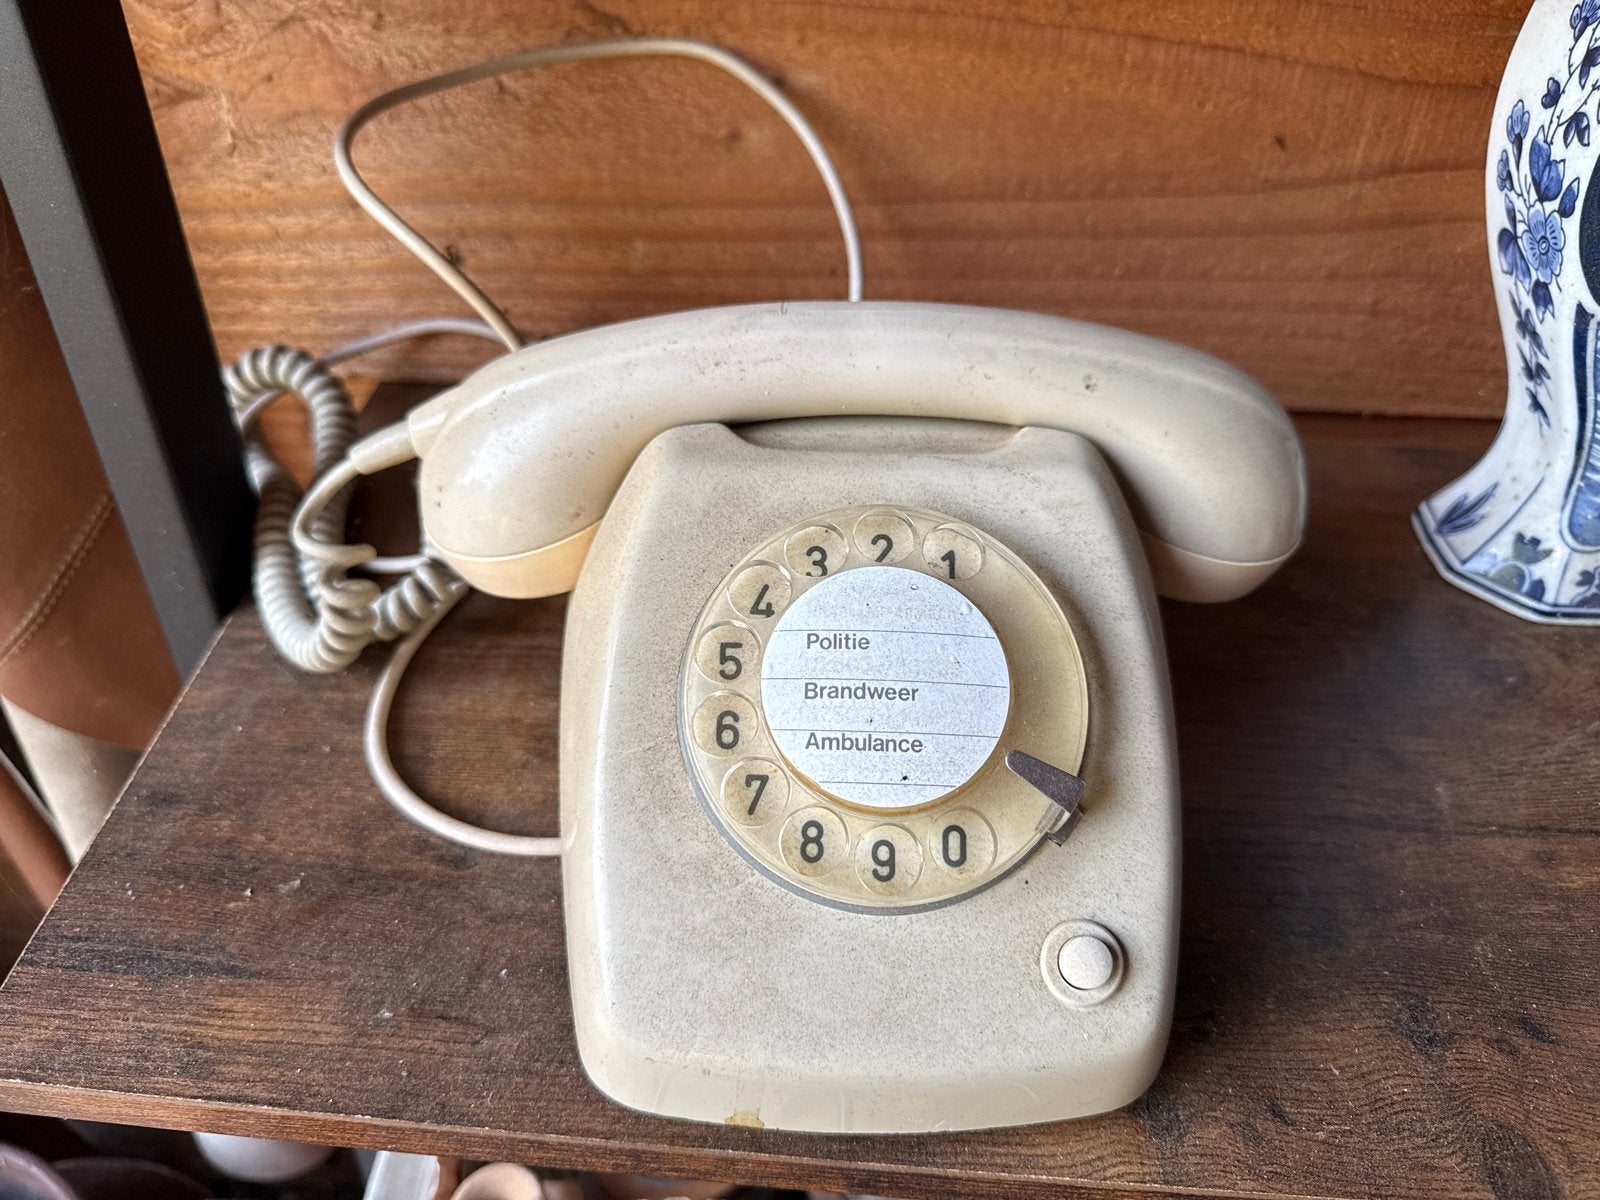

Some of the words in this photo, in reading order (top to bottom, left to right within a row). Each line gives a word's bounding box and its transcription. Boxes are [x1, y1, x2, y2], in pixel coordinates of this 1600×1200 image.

[805, 545, 828, 577] 3
[871, 533, 893, 562] 2
[940, 549, 956, 580] 1
[749, 583, 775, 619] 4
[806, 633, 870, 650] Politie
[718, 642, 743, 680] 5
[804, 682, 919, 702] Brandweer
[715, 710, 740, 750] 6
[805, 732, 923, 753] Ambulance
[744, 774, 770, 816] 7
[800, 820, 824, 864] 8
[942, 824, 967, 868] 0
[871, 839, 896, 883] 9
